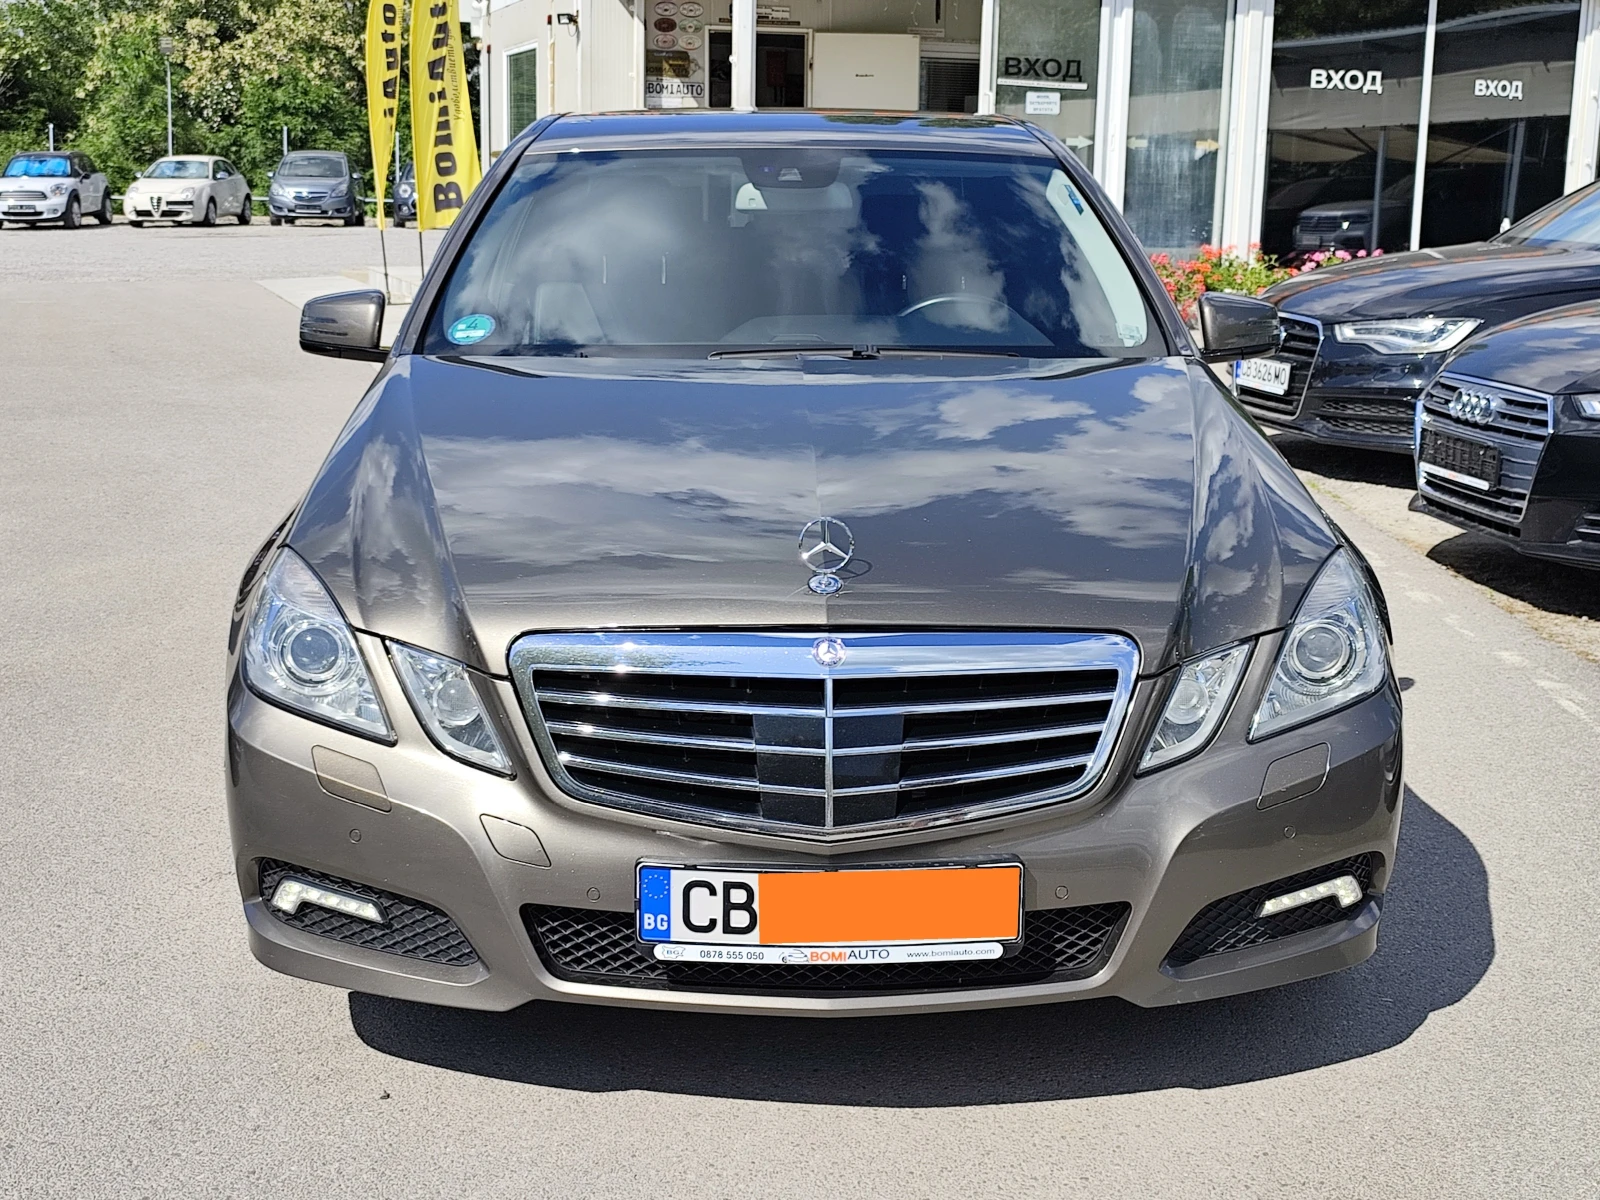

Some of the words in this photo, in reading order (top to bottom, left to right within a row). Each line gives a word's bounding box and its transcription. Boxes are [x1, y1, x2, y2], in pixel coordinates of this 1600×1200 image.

[1004, 57, 1083, 82] ВХОД
[647, 82, 703, 96] BOMIAUTO
[1310, 68, 1383, 94] ВХОД
[1474, 78, 1523, 100] ВХОД
[467, 318, 478, 330] 4
[681, 880, 758, 935] CB
[643, 913, 669, 931] BG
[700, 949, 723, 959] 0878
[726, 950, 744, 960] 555
[746, 951, 765, 960] 050
[906, 947, 996, 959] www.bomiauto.com
